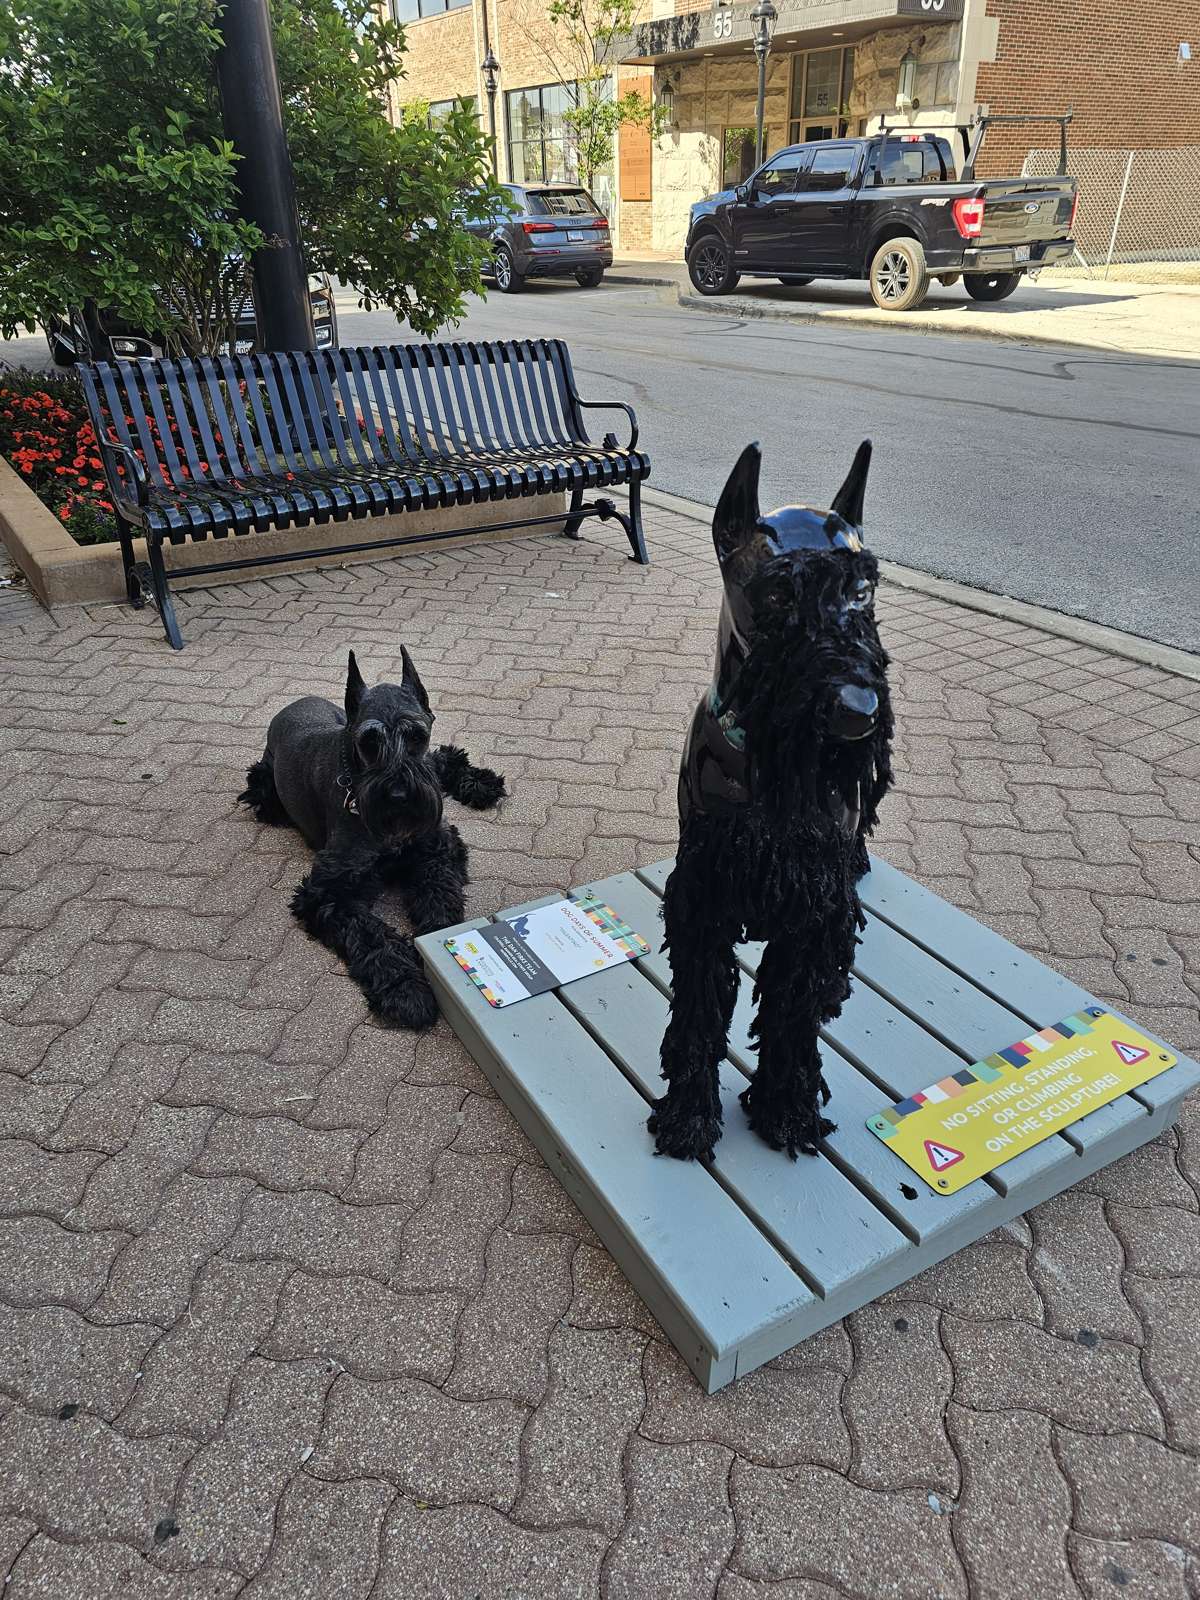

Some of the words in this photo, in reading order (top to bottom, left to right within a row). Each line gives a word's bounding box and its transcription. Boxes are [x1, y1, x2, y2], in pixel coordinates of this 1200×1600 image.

[714, 11, 732, 38] 55
[560, 907, 574, 918] DOG
[571, 917, 586, 930] DAYS
[590, 936, 613, 958] SUMMER
[525, 962, 538, 975] TEAM
[941, 1112, 968, 1131] NO
[966, 1082, 1030, 1118] SITTING,
[1024, 1047, 1098, 1086] STANDING,
[985, 1130, 1013, 1152] ON
[1008, 1116, 1043, 1139] THE
[1039, 1072, 1122, 1122] SCULPTURE!
[993, 1107, 1019, 1125] OR
[1015, 1072, 1083, 1112] CLIMBING
